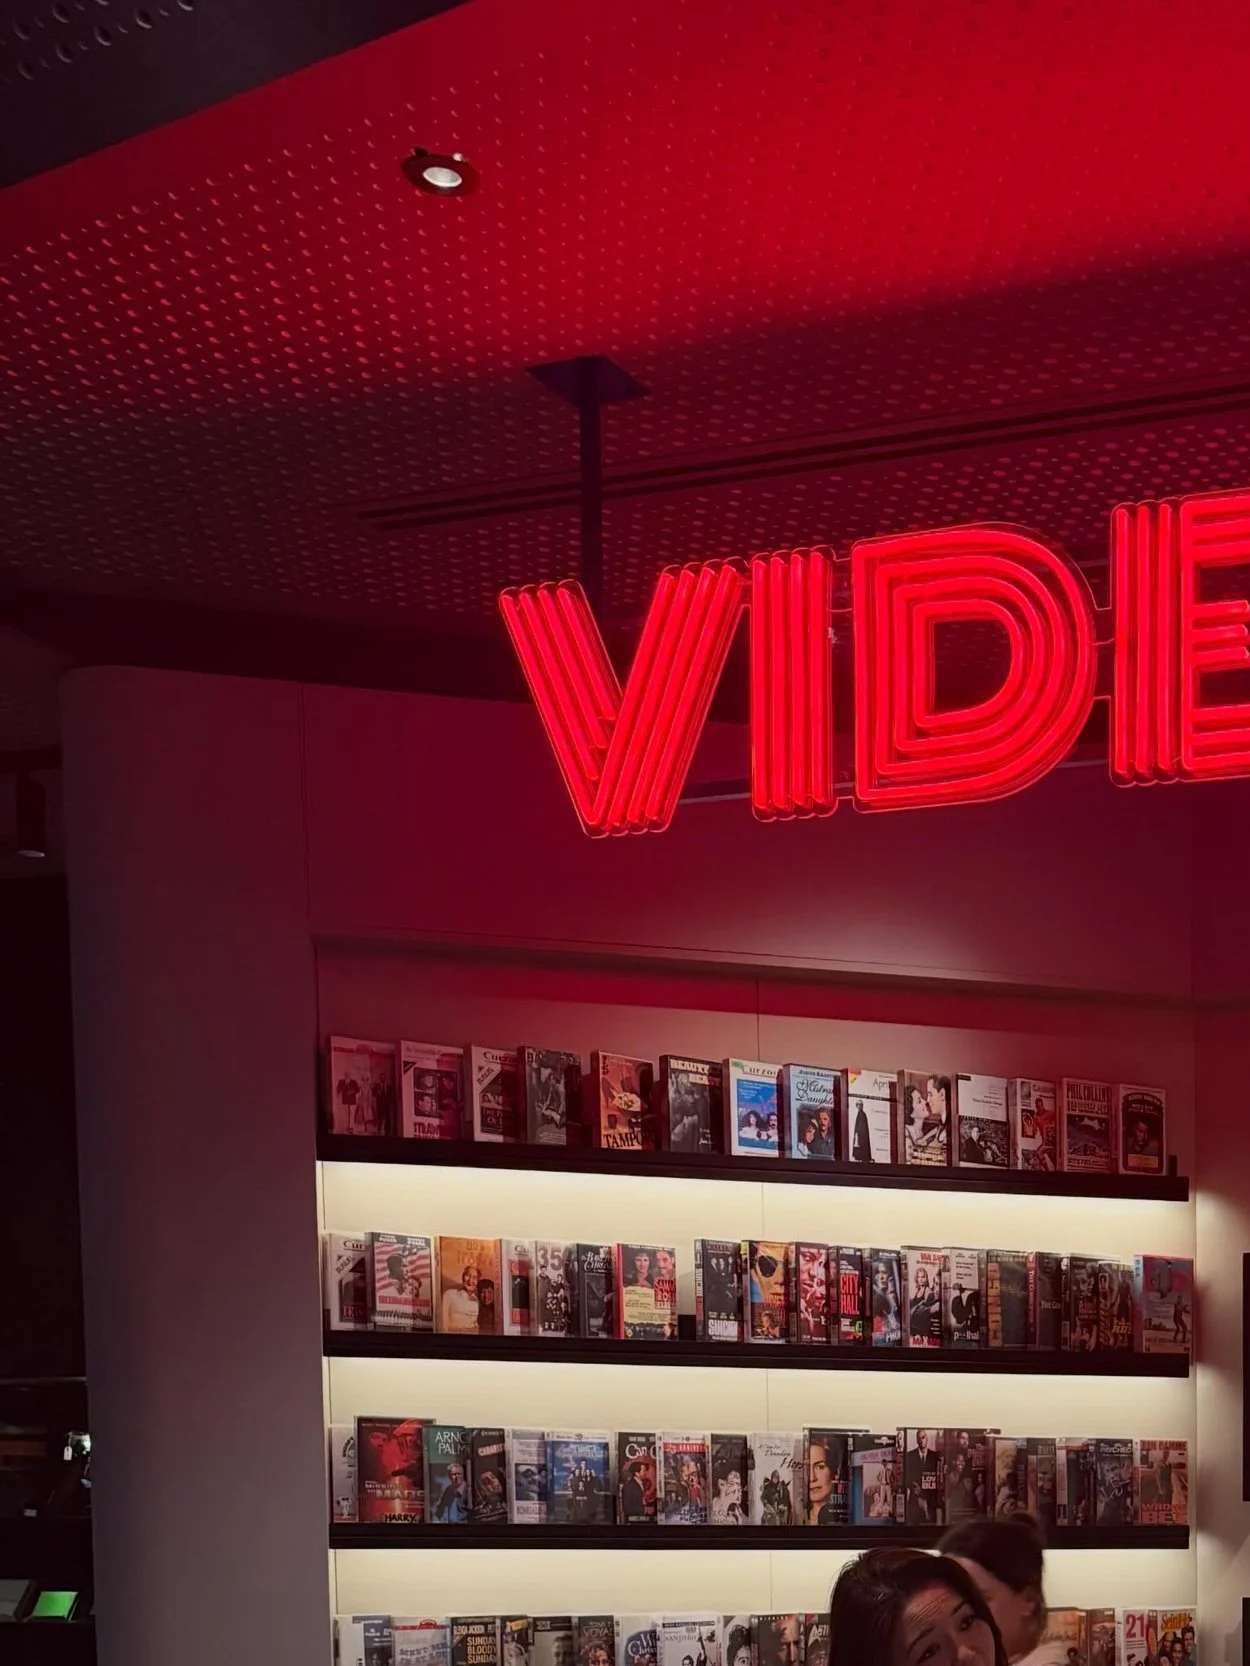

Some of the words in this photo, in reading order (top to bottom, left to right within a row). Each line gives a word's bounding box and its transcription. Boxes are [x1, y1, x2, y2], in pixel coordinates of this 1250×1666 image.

[840, 1273, 859, 1294] CITY
[840, 1294, 860, 1316] HALL
[1125, 1613, 1145, 1639] 21
[467, 1636, 496, 1646] SUNDAY
[467, 1645, 496, 1655] BLOODY
[467, 1654, 496, 1664] SUNDAY
